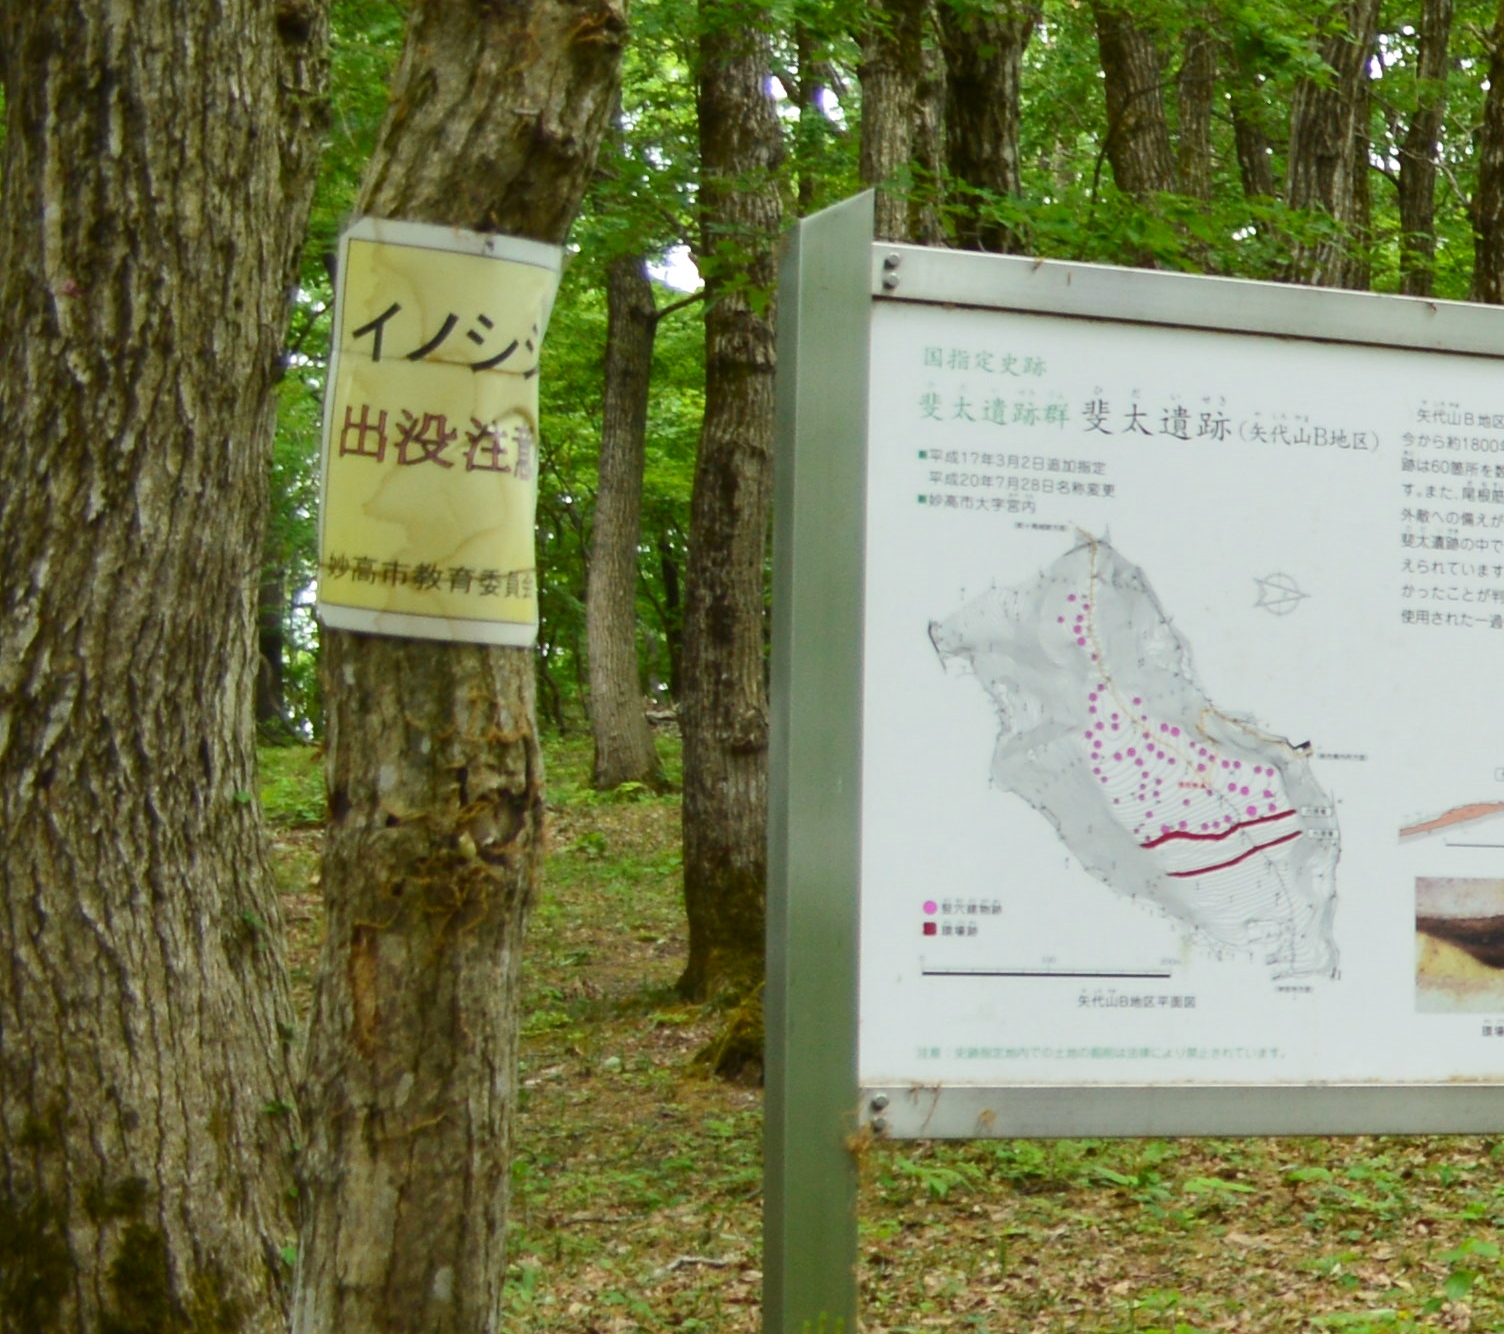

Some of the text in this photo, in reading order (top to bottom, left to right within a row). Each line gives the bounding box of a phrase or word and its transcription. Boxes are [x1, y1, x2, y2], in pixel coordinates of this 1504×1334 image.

[924, 346, 1047, 377] 国指定史跡
[929, 449, 1106, 475] 平成17年3月2日追加指定
[929, 471, 1116, 498] 平成20年7月28日名称変更
